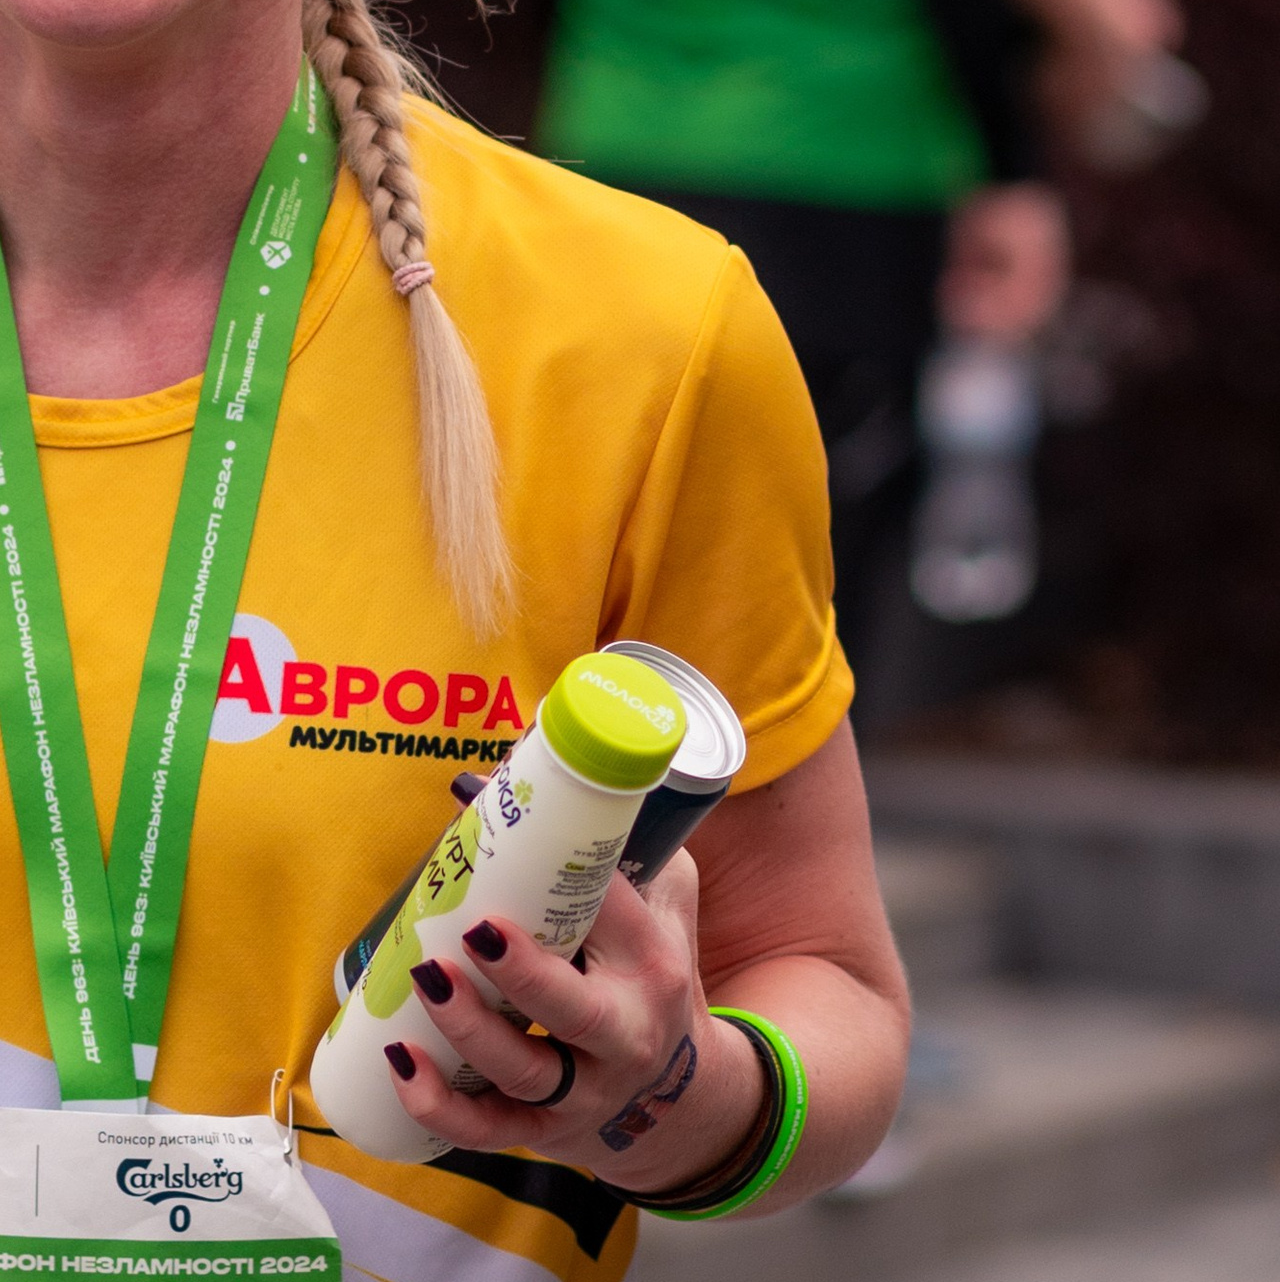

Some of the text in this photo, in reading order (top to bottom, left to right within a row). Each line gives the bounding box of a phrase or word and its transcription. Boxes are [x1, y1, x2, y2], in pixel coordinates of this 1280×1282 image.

[234, 312, 266, 404] ПриватБанк
[216, 636, 523, 730] АВРОРА
[123, 456, 234, 999] ДЕНЬ 963: КИЇВСЬКИЙ МАРАФОН НЕЗЛАМНОСТІ 2024
[289, 726, 516, 763] МУЛЬТИМАРКЕ
[2, 524, 100, 1064] ДЕНЬ 963: КИЇВСЬКИЙ МАРАФОН НЕЗЛАМНОСТІ 2024
[98, 1130, 253, 1149] Спонсор дистанції 10 км
[116, 1157, 243, 1205] Carlsberg
[61, 1254, 255, 1276] НЕЗЛАМНОСТІ
[259, 1256, 328, 1274] 2024
